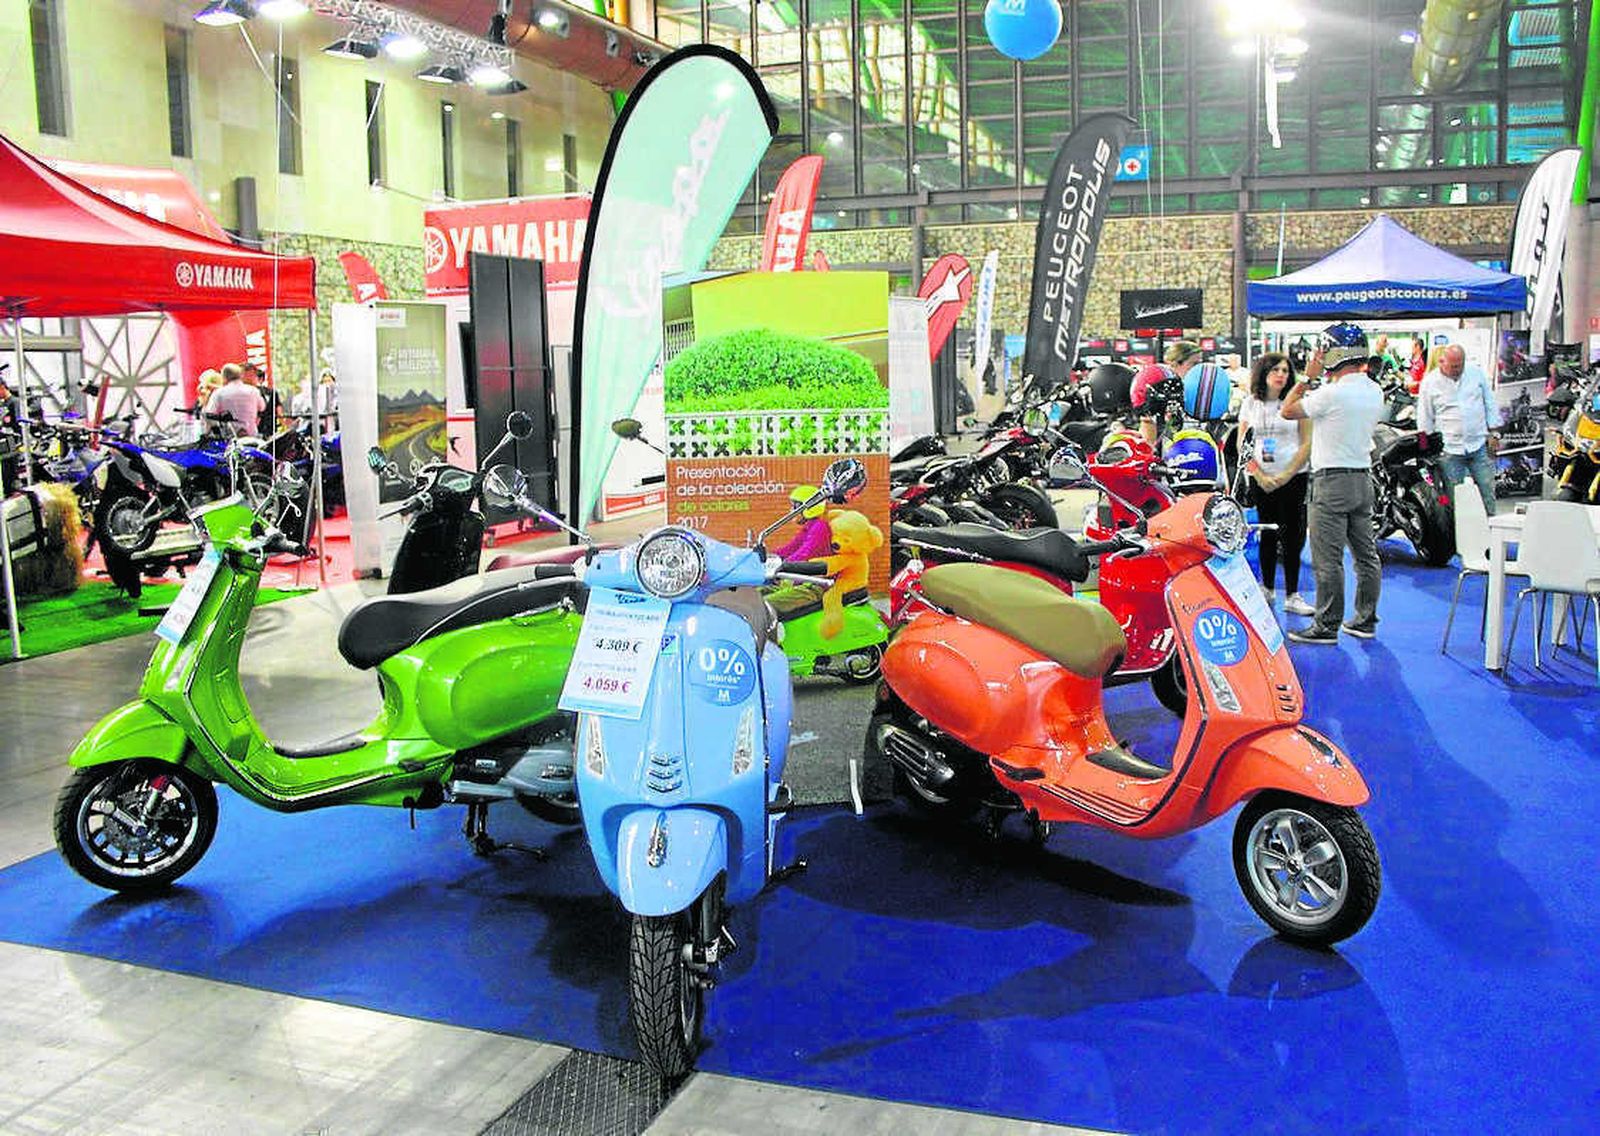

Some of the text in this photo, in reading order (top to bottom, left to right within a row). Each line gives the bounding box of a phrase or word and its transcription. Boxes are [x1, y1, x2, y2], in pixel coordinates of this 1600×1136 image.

[1043, 164, 1083, 323] PEUGEOT
[1055, 137, 1111, 361] METROPOLIS
[194, 263, 254, 290] YAMAHA
[1296, 287, 1468, 303] www.peugeotscooters.es
[676, 465, 766, 479] Presentación
[676, 480, 785, 496] de la colección
[676, 501, 750, 513] de colores
[677, 515, 709, 528] 2017
[1198, 613, 1237, 640] 0%
[699, 647, 745, 675] 0%
[584, 676, 618, 692] 4.059
[719, 689, 730, 701] M
